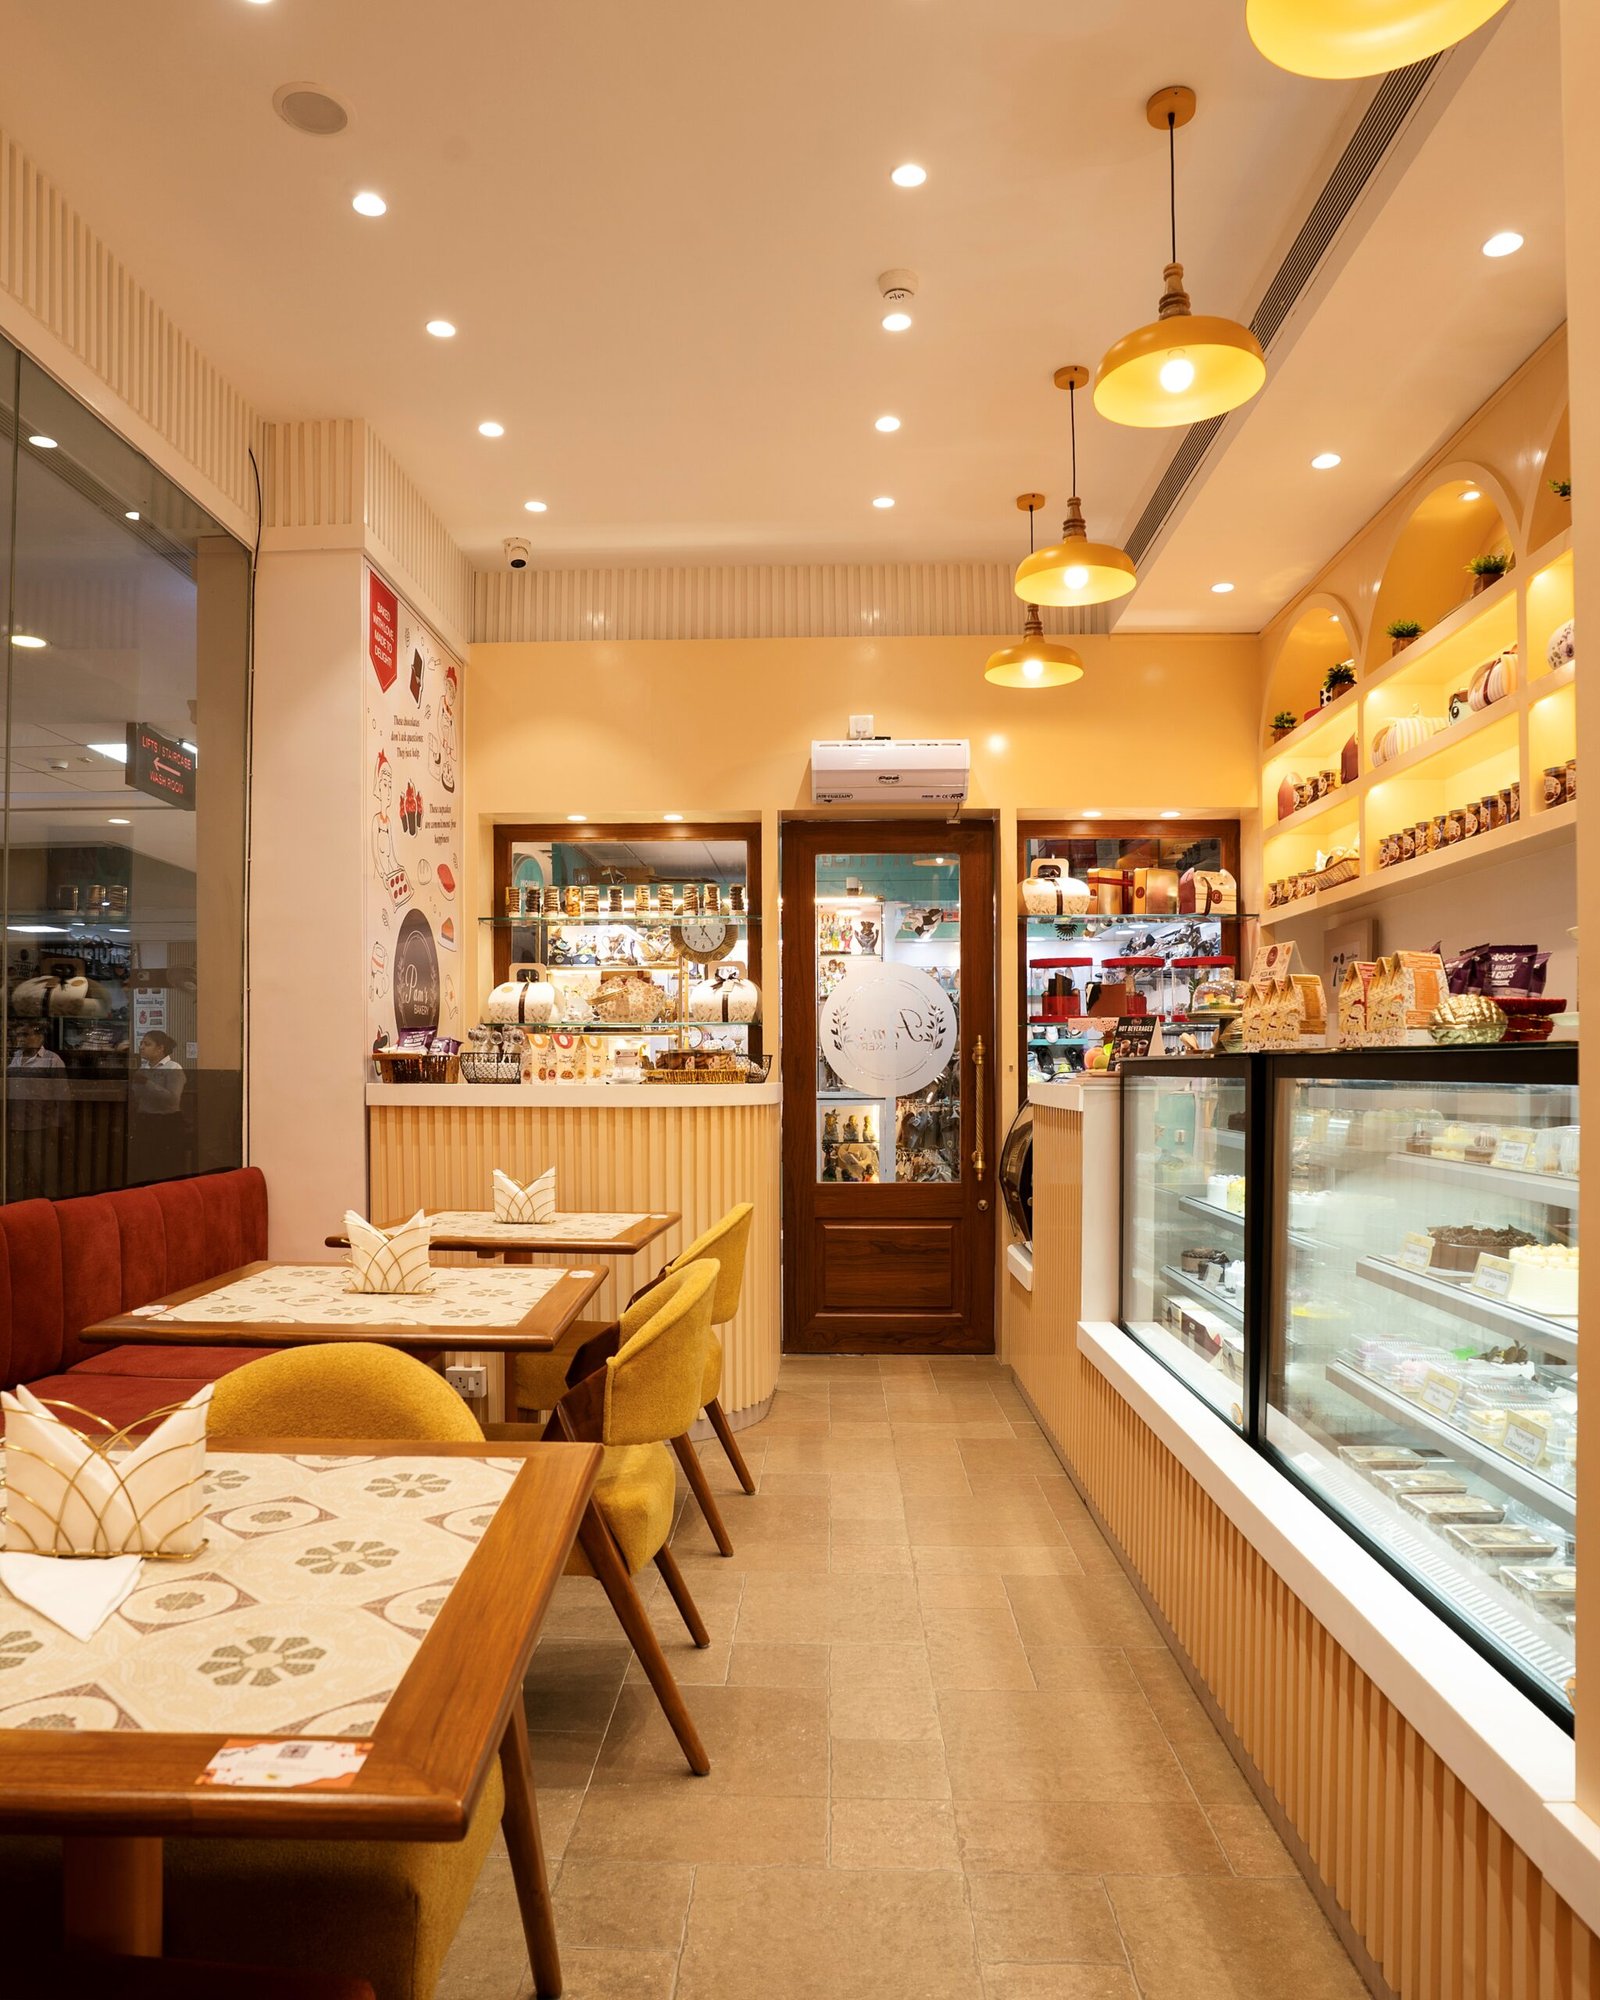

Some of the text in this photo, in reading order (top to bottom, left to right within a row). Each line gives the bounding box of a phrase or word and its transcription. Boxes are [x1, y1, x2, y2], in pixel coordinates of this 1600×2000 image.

[376, 601, 391, 622] BAKED
[374, 629, 393, 654] MADE TO
[393, 714, 403, 726] These
[142, 735, 158, 753] LIFTS
[161, 746, 192, 771] STAIRCASE
[396, 746, 404, 760] They
[150, 771, 184, 794] WASH ROOM
[413, 1003, 430, 1016] BAKERY
